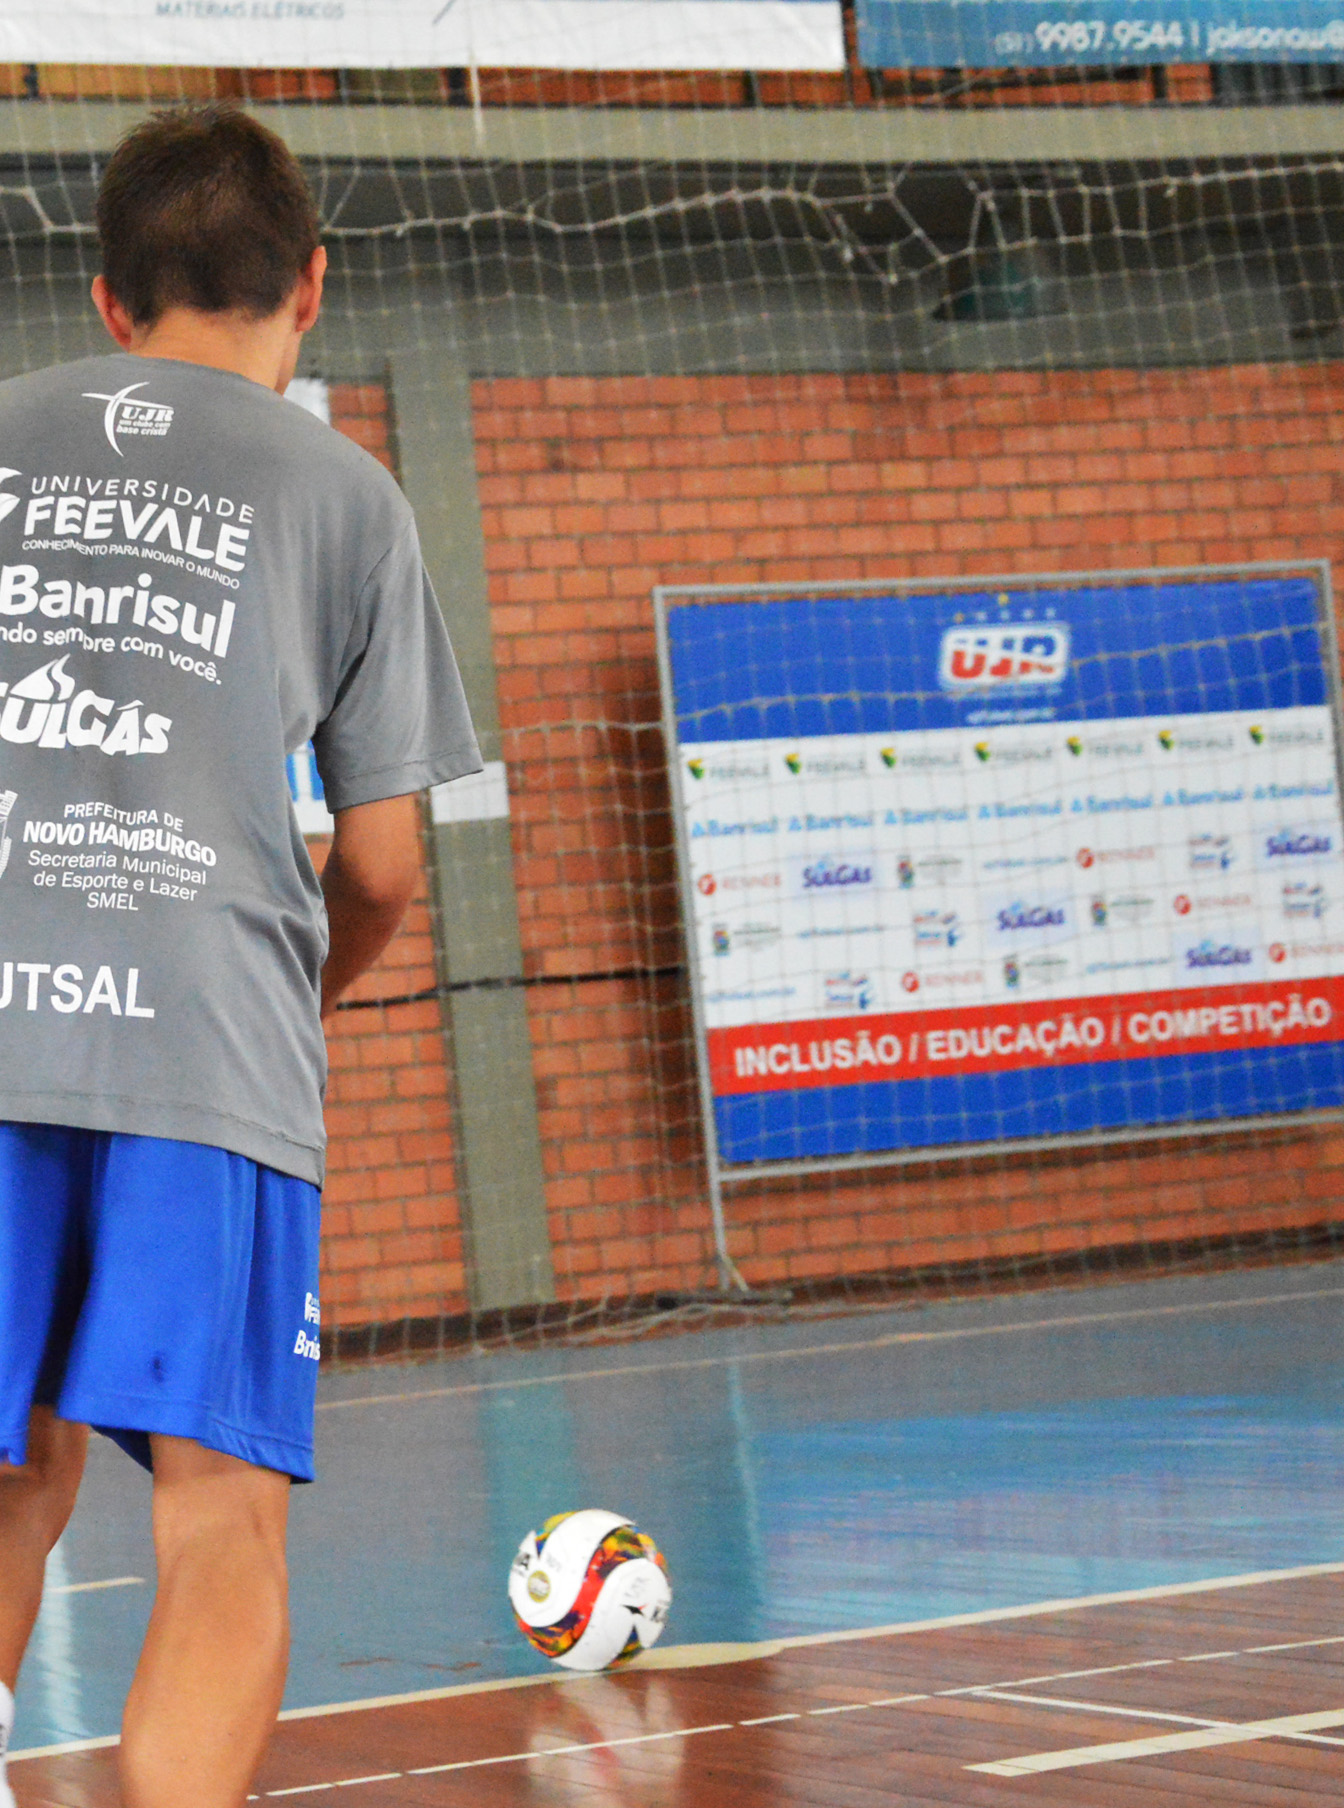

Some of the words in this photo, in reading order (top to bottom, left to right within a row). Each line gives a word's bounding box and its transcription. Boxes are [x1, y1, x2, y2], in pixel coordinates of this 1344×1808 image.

[116, 424, 139, 434] base
[121, 406, 175, 421] UJR
[30, 475, 255, 525] UNIVERSIDADE
[23, 495, 251, 572] FEEVALE
[22, 539, 107, 556] CONHECIMENTO
[109, 544, 139, 558] PARA
[141, 546, 184, 569] INOVAR
[185, 561, 196, 571] O
[196, 563, 241, 590] MUNDO
[43, 627, 116, 653] sempre
[121, 635, 164, 658] com
[168, 650, 223, 685] você.
[64, 802, 158, 825] PREFEITURA
[164, 812, 184, 832] DE
[23, 820, 85, 846] NOVO
[88, 822, 217, 867] HAMBURGO
[28, 850, 117, 869] Secretaria
[122, 856, 206, 886] Municipal
[33, 870, 56, 887] de
[61, 872, 129, 891] Esporte
[133, 880, 144, 891] e
[150, 879, 198, 901] Lazer
[87, 892, 139, 911] SMEL
[734, 1030, 903, 1078] INCLUSÃO
[926, 1012, 1106, 1061] EDUCAÇÃO
[1127, 993, 1332, 1043] COMPETIÇÃO
